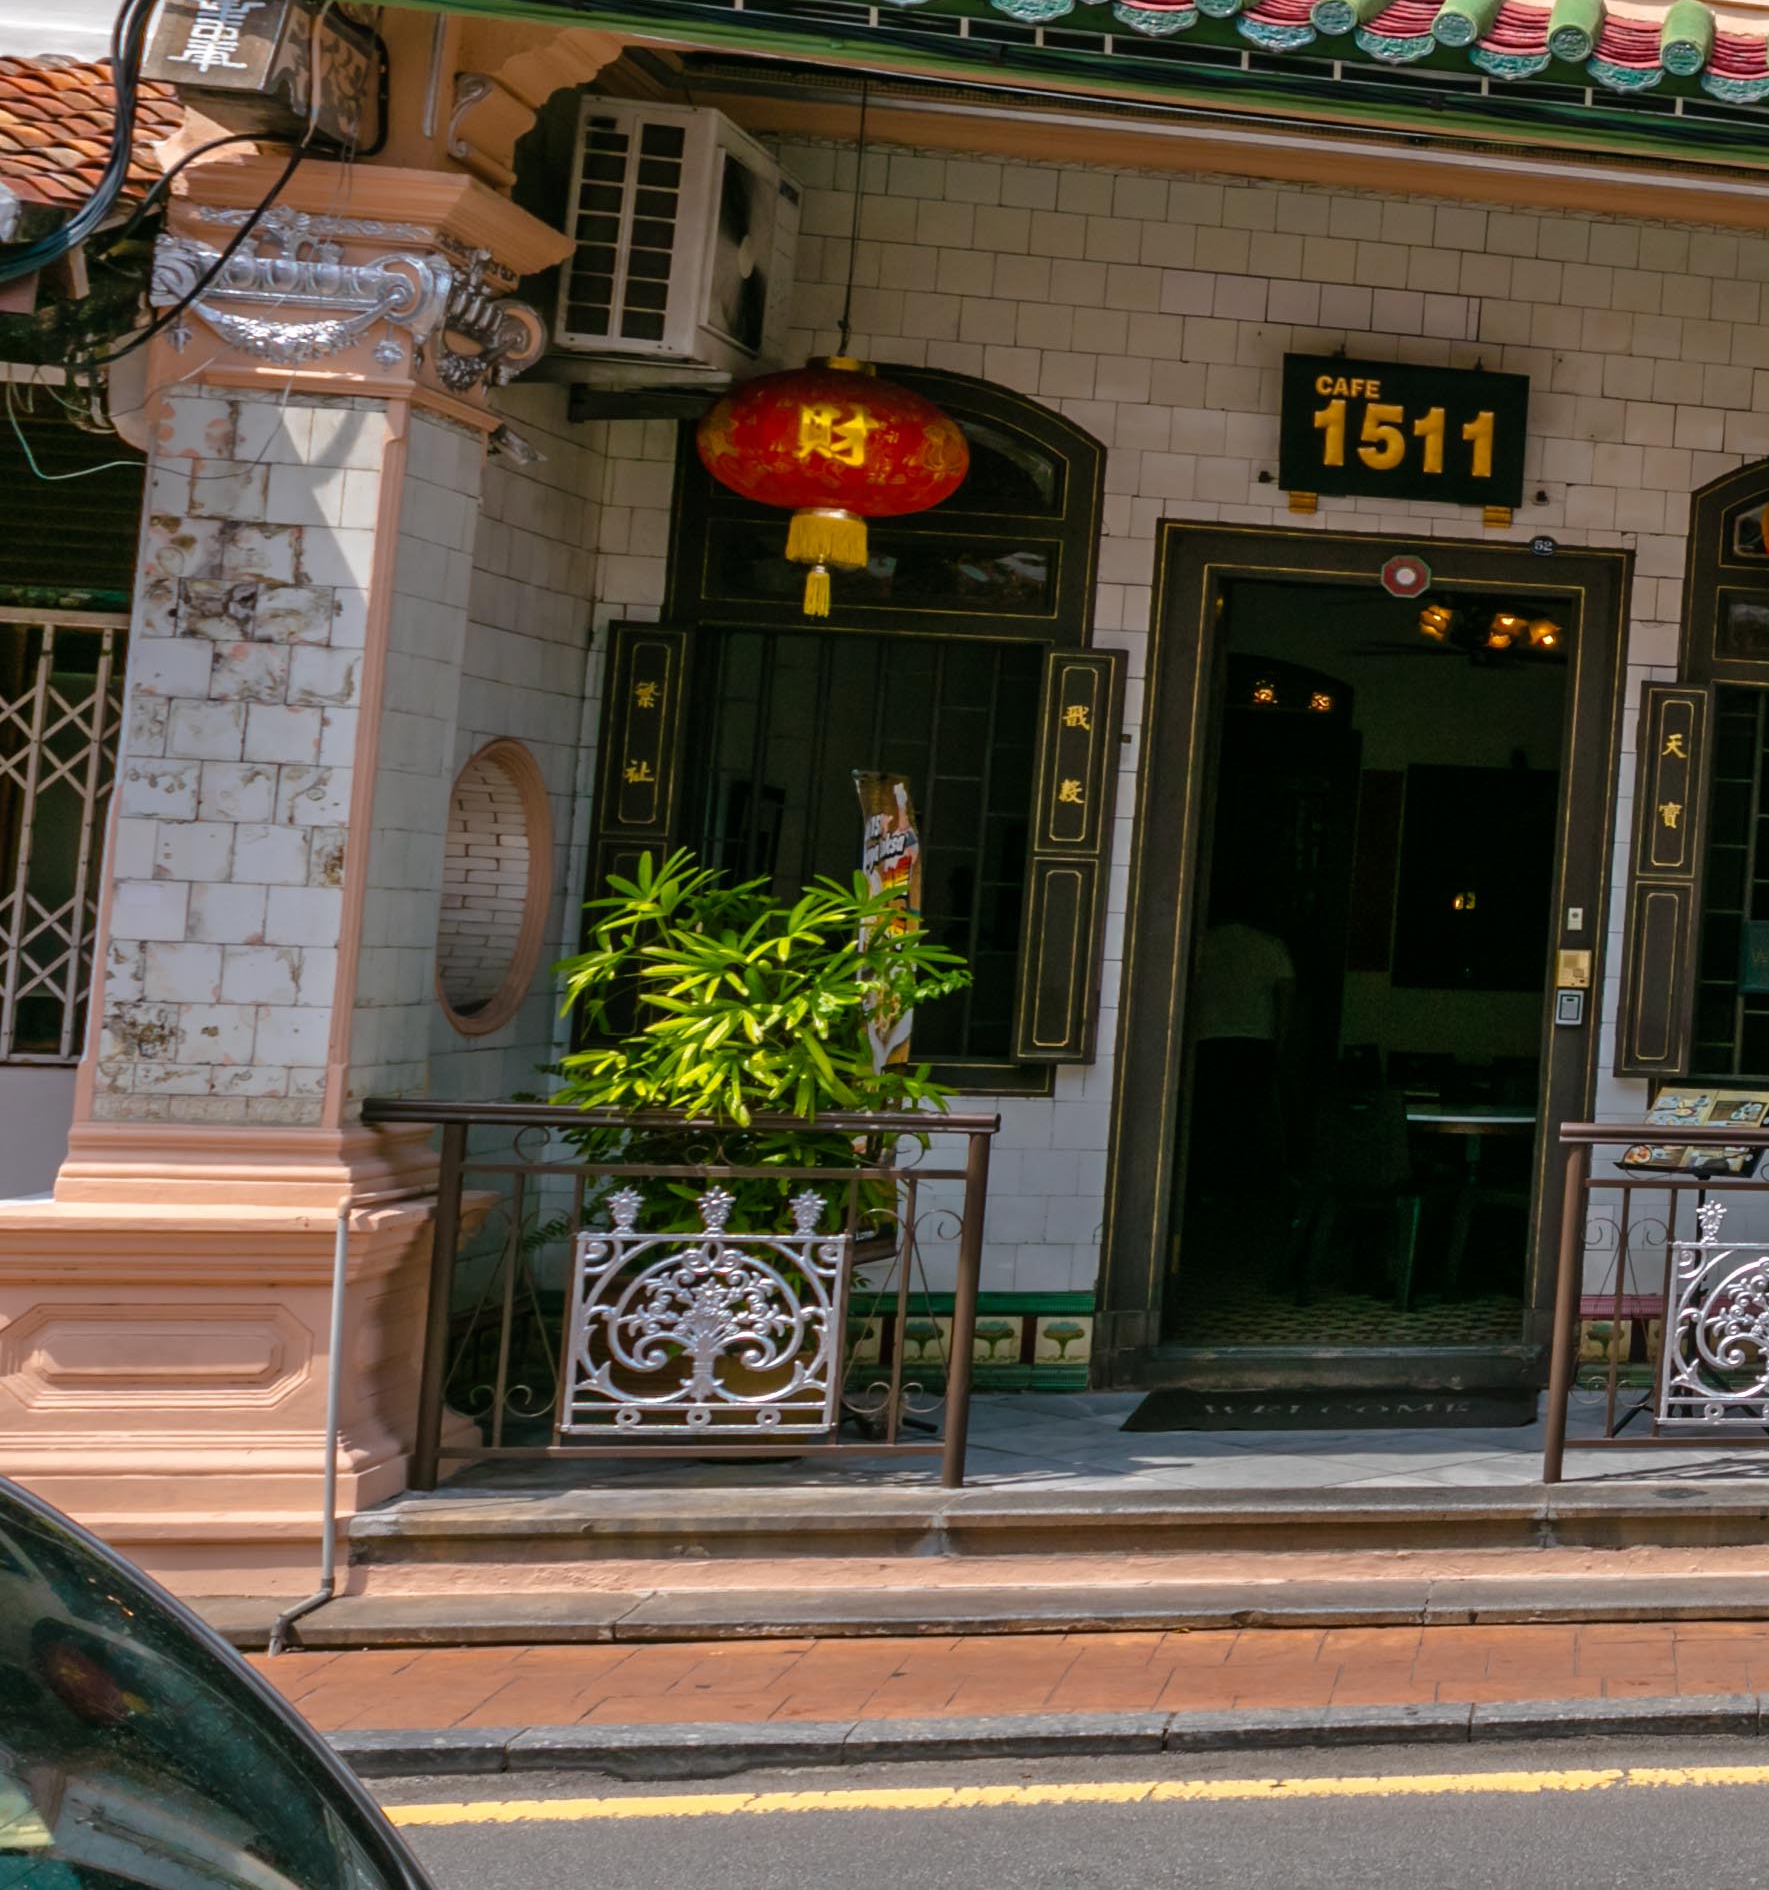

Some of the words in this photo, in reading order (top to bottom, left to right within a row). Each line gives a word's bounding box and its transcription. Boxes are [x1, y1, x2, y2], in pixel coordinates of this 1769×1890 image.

[1314, 374, 1382, 400] CAFE
[792, 402, 882, 466] 財
[1313, 398, 1495, 478] 1511
[1533, 539, 1554, 553] 52
